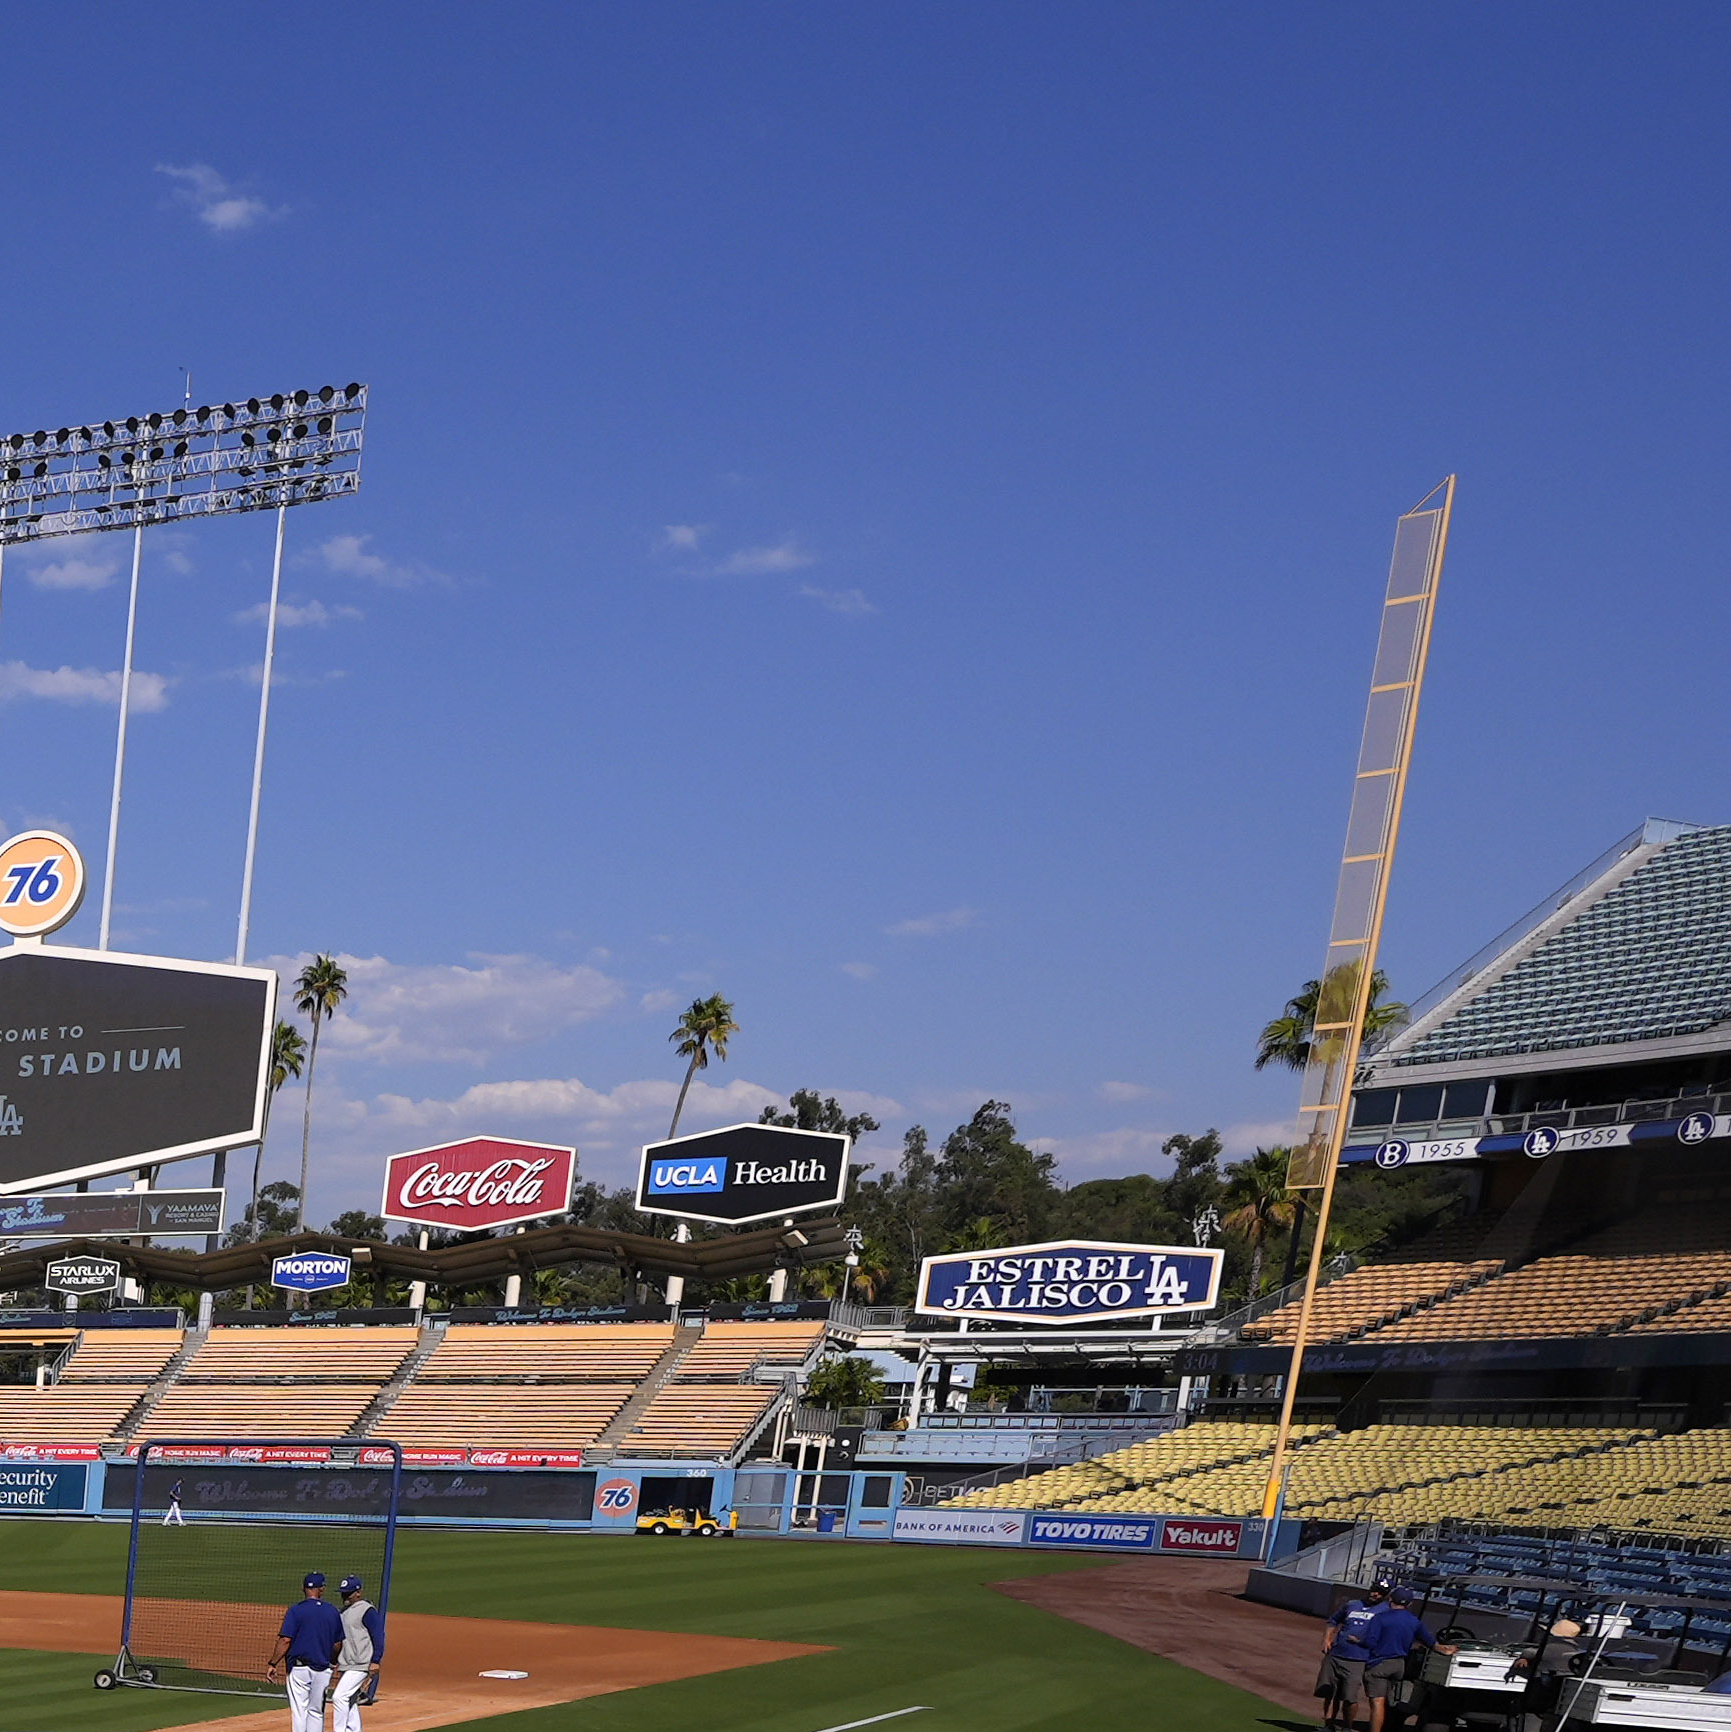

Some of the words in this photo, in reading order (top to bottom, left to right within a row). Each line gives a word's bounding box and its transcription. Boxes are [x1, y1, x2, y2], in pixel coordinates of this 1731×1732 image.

[0, 854, 64, 907] 76
[58, 1025, 85, 1040] TO
[18, 1047, 182, 1076] STADIUM
[1572, 1128, 1617, 1147] 1959
[1420, 1141, 1464, 1159] 1955
[399, 1156, 556, 1209] Coca-Cola
[655, 1163, 719, 1190] UCLA
[733, 1158, 828, 1186] Health
[26, 1198, 44, 1214] To
[2, 1211, 65, 1229] Stadium
[50, 1265, 115, 1278] STARLUX
[276, 1260, 347, 1275] MORTON
[965, 1255, 1144, 1285] ESTREL
[59, 1276, 106, 1285] AIRLINES
[943, 1282, 1133, 1311] JALISCO
[1184, 1354, 1218, 1370] 3:04
[470, 1451, 507, 1465] Coca-Cola
[559, 1455, 579, 1463] TIME
[686, 1468, 707, 1478] 360
[599, 1487, 634, 1510] 76
[896, 1522, 927, 1532] BANK
[928, 1523, 944, 1533] OF
[945, 1523, 995, 1534] AMERICA
[1248, 1522, 1264, 1533] 330
[1166, 1527, 1236, 1547] Yakult
